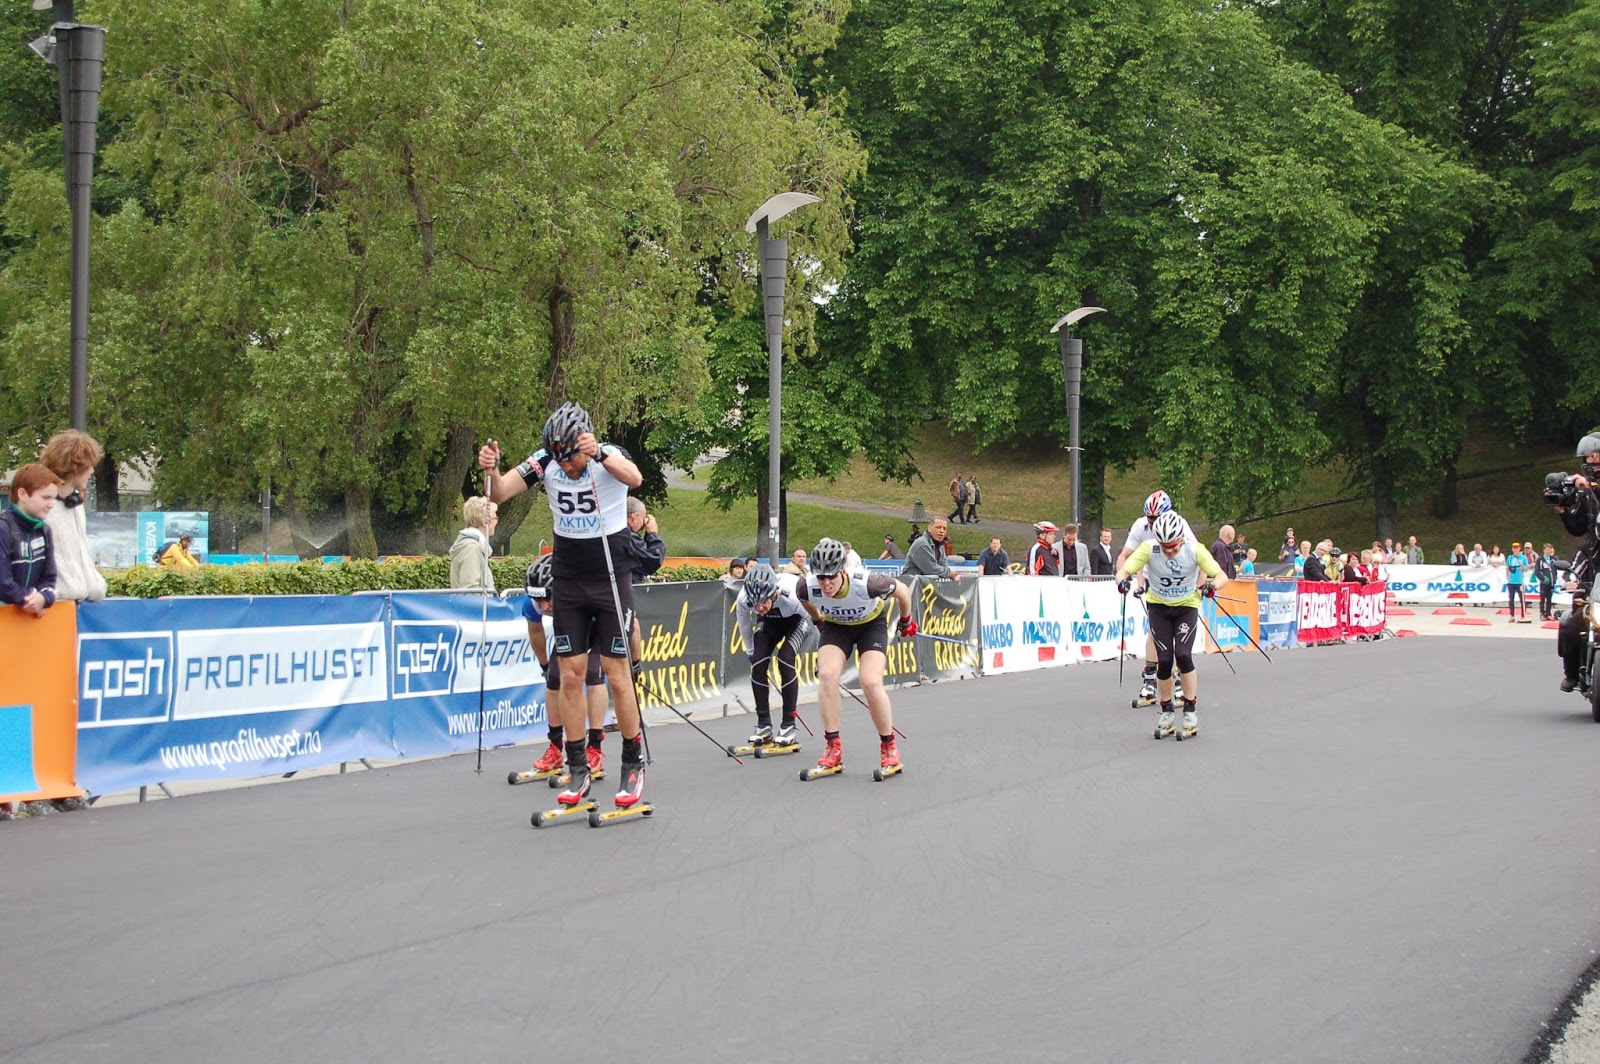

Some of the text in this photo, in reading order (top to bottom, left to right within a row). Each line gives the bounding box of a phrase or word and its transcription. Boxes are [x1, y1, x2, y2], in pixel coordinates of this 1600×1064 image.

[558, 489, 597, 515] 55
[560, 517, 597, 528] AKTIV
[1160, 576, 1186, 587] 37
[1427, 582, 1491, 592] MAXBO
[983, 622, 1013, 649] MAXBO
[1023, 621, 1061, 645] MAXBO
[462, 638, 538, 670] PROFIL
[185, 646, 379, 692] PROFILHUSET
[636, 660, 721, 711] BAKERIES
[448, 699, 547, 739] www.profilhuset.n
[160, 728, 322, 771] www.profilhuset.no
